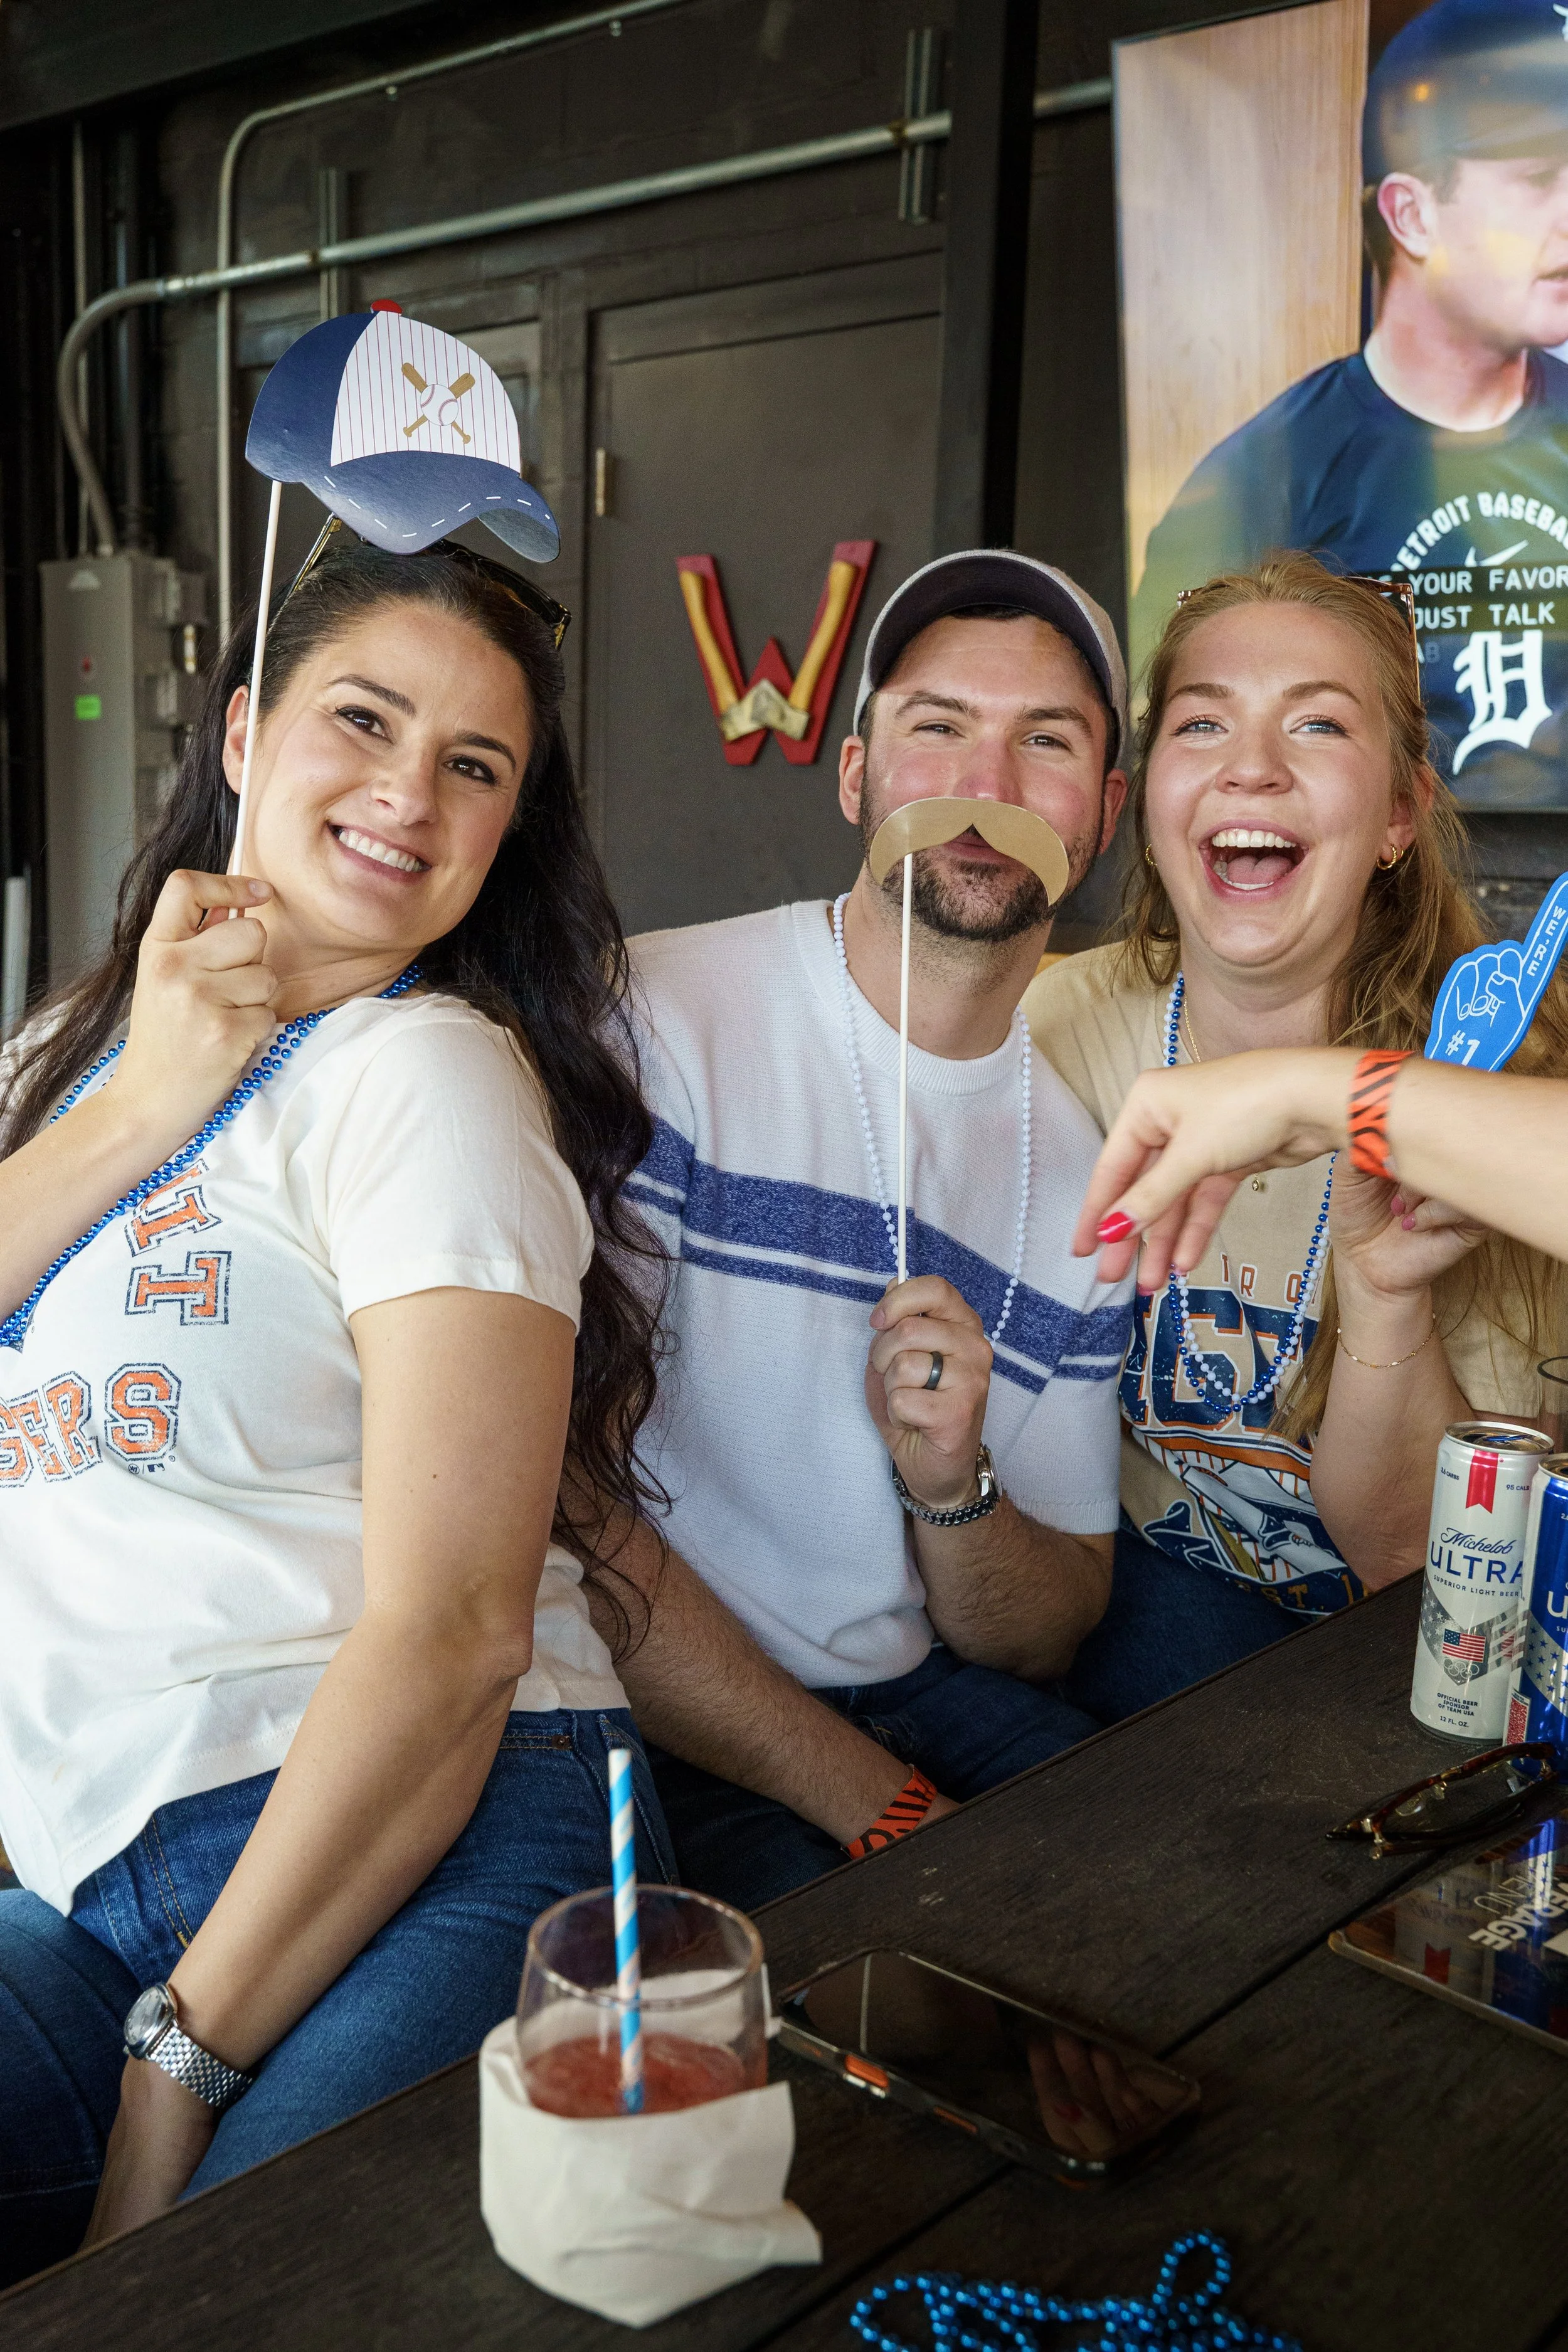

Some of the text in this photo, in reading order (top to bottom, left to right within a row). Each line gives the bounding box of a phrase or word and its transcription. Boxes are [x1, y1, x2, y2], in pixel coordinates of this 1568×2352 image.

[1408, 569, 1473, 596] YOUR
[1414, 601, 1555, 630] JUST TALK
[675, 539, 879, 766] W
[1444, 1029, 1480, 1066] #1
[1441, 1527, 1517, 1554] Michelob
[1434, 1574, 1466, 1591] SUPERIOR
[1470, 1586, 1496, 1597] LIGHT
[1437, 1692, 1461, 1703] OFFICIAL
[1443, 1700, 1470, 1710] SPONSOR
[1446, 1705, 1461, 1714] TEAM
[1468, 1882, 1568, 1952] ERAGE
